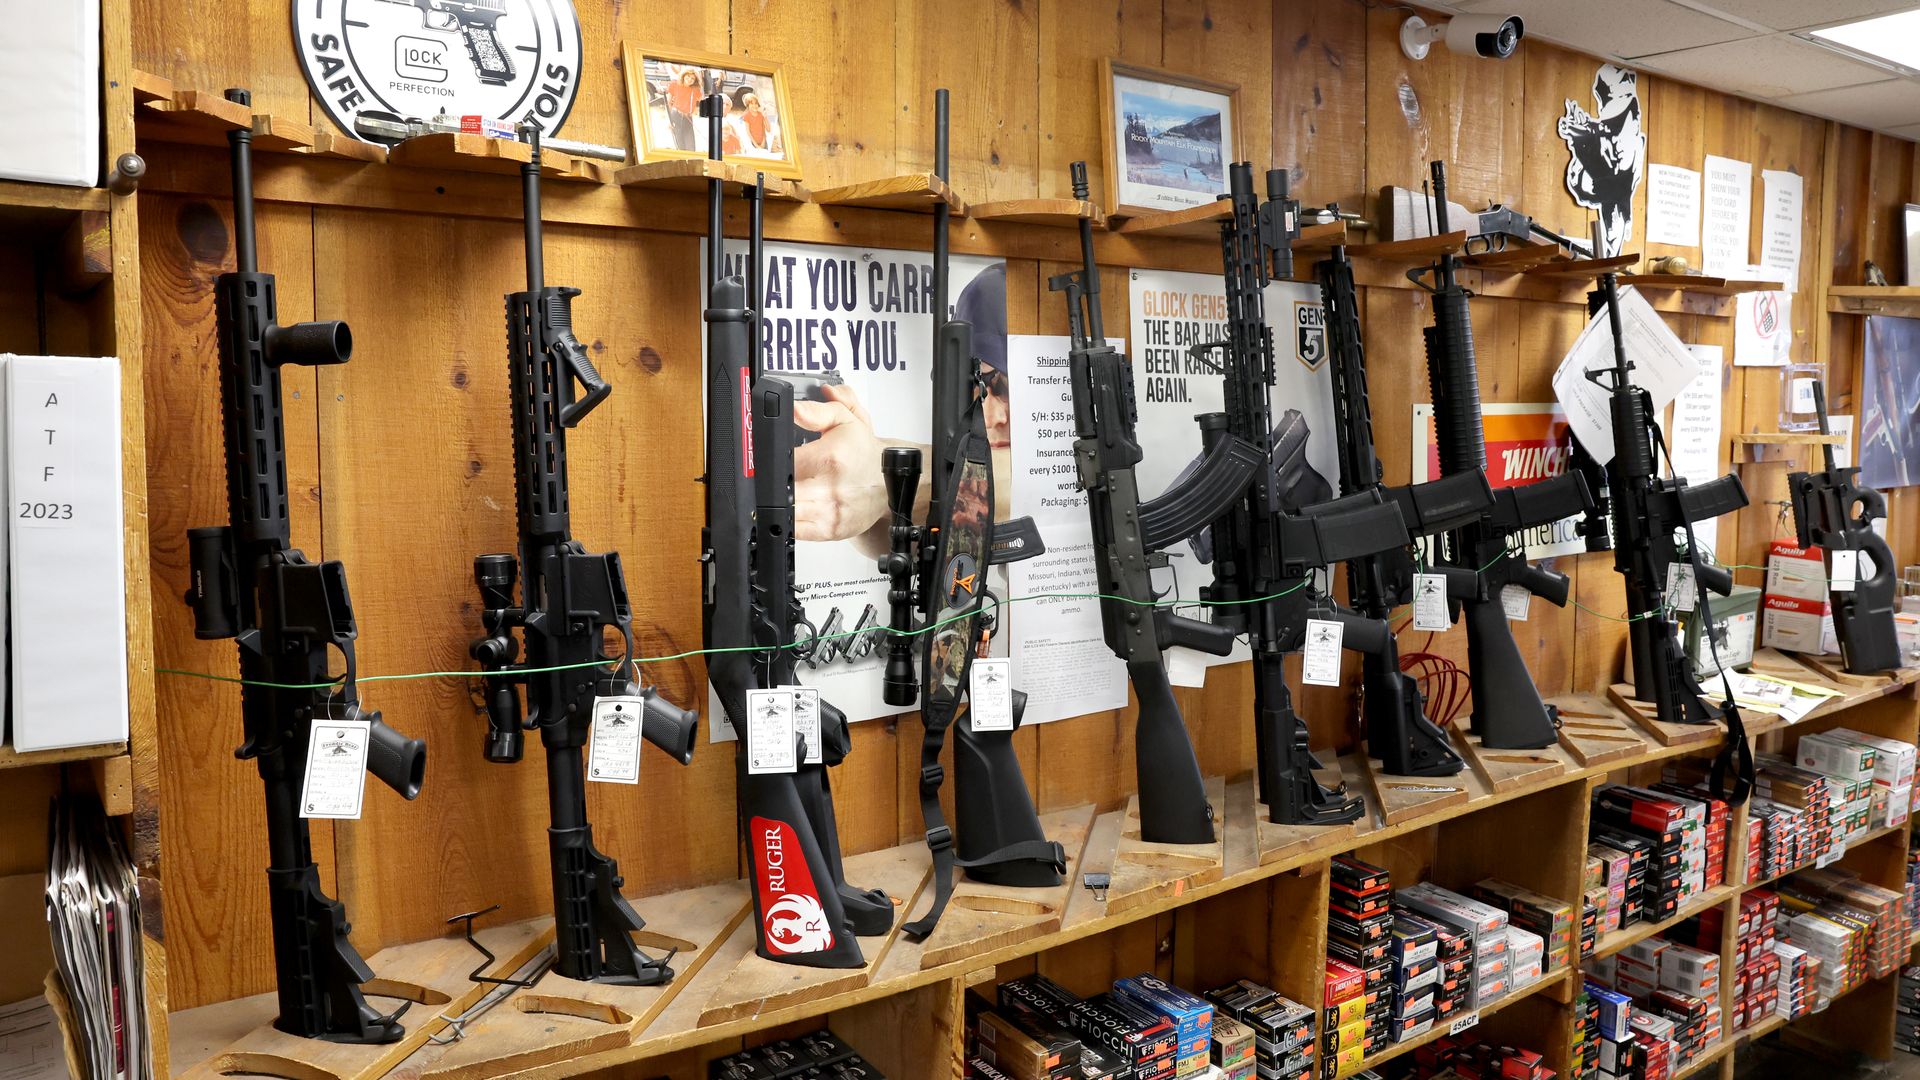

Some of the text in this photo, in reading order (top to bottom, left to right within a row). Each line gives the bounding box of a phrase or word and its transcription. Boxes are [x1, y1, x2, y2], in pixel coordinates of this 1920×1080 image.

[311, 32, 366, 112] SAFE
[389, 81, 455, 97] PERFECTION
[806, 258, 857, 312] YOU
[868, 261, 955, 318] CARR,
[1143, 290, 1188, 317] GLOCK
[1298, 306, 1324, 326] GEN
[1143, 319, 1231, 346] THE BAR HAS
[763, 318, 907, 372] RRIES YOU.
[1303, 330, 1321, 359] 5
[1145, 348, 1223, 375] BEEN RAISE
[1028, 376, 1061, 385] Transfer
[1146, 377, 1192, 403] AGAIN.
[744, 375, 755, 470] RUGER
[1032, 412, 1049, 422] S/H:
[1051, 412, 1065, 422] $35
[1037, 429, 1052, 439] $50
[1053, 431, 1066, 439] per
[1502, 446, 1571, 480] WINCH
[1029, 465, 1071, 476] every $100
[1041, 497, 1081, 508] Packaging:
[19, 502, 73, 520] 2023
[1509, 516, 1582, 549] merica
[1047, 544, 1086, 554] Non-resident
[1774, 545, 1806, 555] Aguila
[1032, 557, 1088, 568] surrounding states
[1028, 571, 1057, 581] Missouri,
[1057, 570, 1082, 578] Indiana,
[814, 582, 833, 590] PLUS,
[1028, 586, 1040, 594] and
[1041, 582, 1072, 592] Kentucky)
[1072, 581, 1084, 589] with
[810, 591, 854, 601] Micro-Compact
[1048, 595, 1066, 604] ONLY
[1768, 598, 1800, 609] Aguila
[754, 759, 760, 767] $
[594, 768, 600, 776] $
[307, 803, 315, 812] $
[765, 826, 785, 893] RUGER
[806, 919, 821, 932] R
[1453, 1015, 1477, 1031] 45ACP
[1080, 1017, 1133, 1059] FIOCCHI
